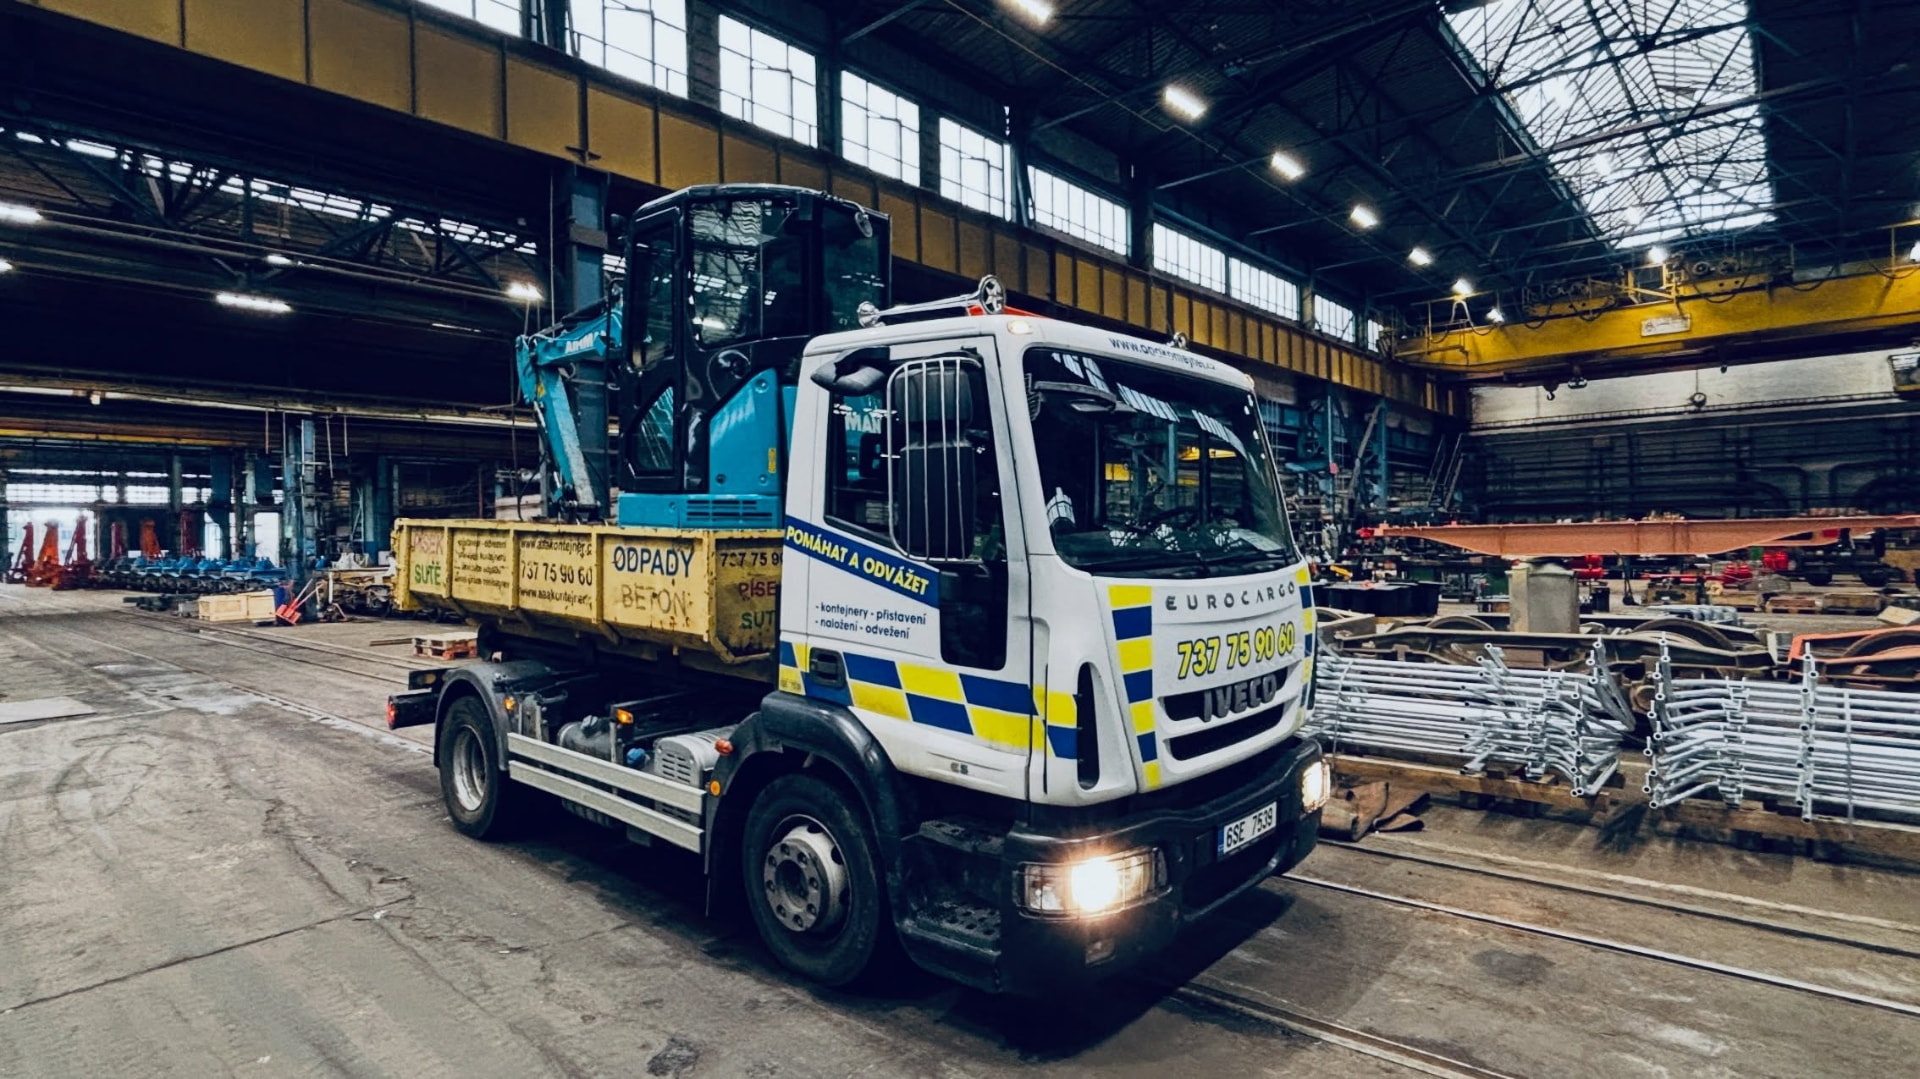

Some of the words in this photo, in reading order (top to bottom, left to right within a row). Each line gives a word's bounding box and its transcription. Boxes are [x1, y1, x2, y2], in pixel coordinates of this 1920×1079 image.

[521, 560, 539, 580] 737
[543, 562, 557, 582] 75
[560, 564, 574, 584] 90
[578, 566, 593, 586] 60
[613, 545, 695, 578] ODPADY
[751, 552, 768, 567] 75
[785, 525, 848, 563] POMÁHAT
[848, 552, 860, 569] A
[863, 557, 930, 596] ODVÁŽET
[620, 582, 688, 617] BETON
[821, 602, 869, 620] kontejnery
[1165, 581, 1295, 611] EUROCARGO
[741, 609, 776, 630] SUT
[1177, 636, 1221, 680] 737
[1226, 631, 1251, 669] 75
[1254, 626, 1275, 663] 90
[1277, 621, 1296, 657] 60
[1203, 674, 1277, 723] IVECO
[1226, 821, 1246, 848] 6SE
[1252, 807, 1273, 836] 7539
